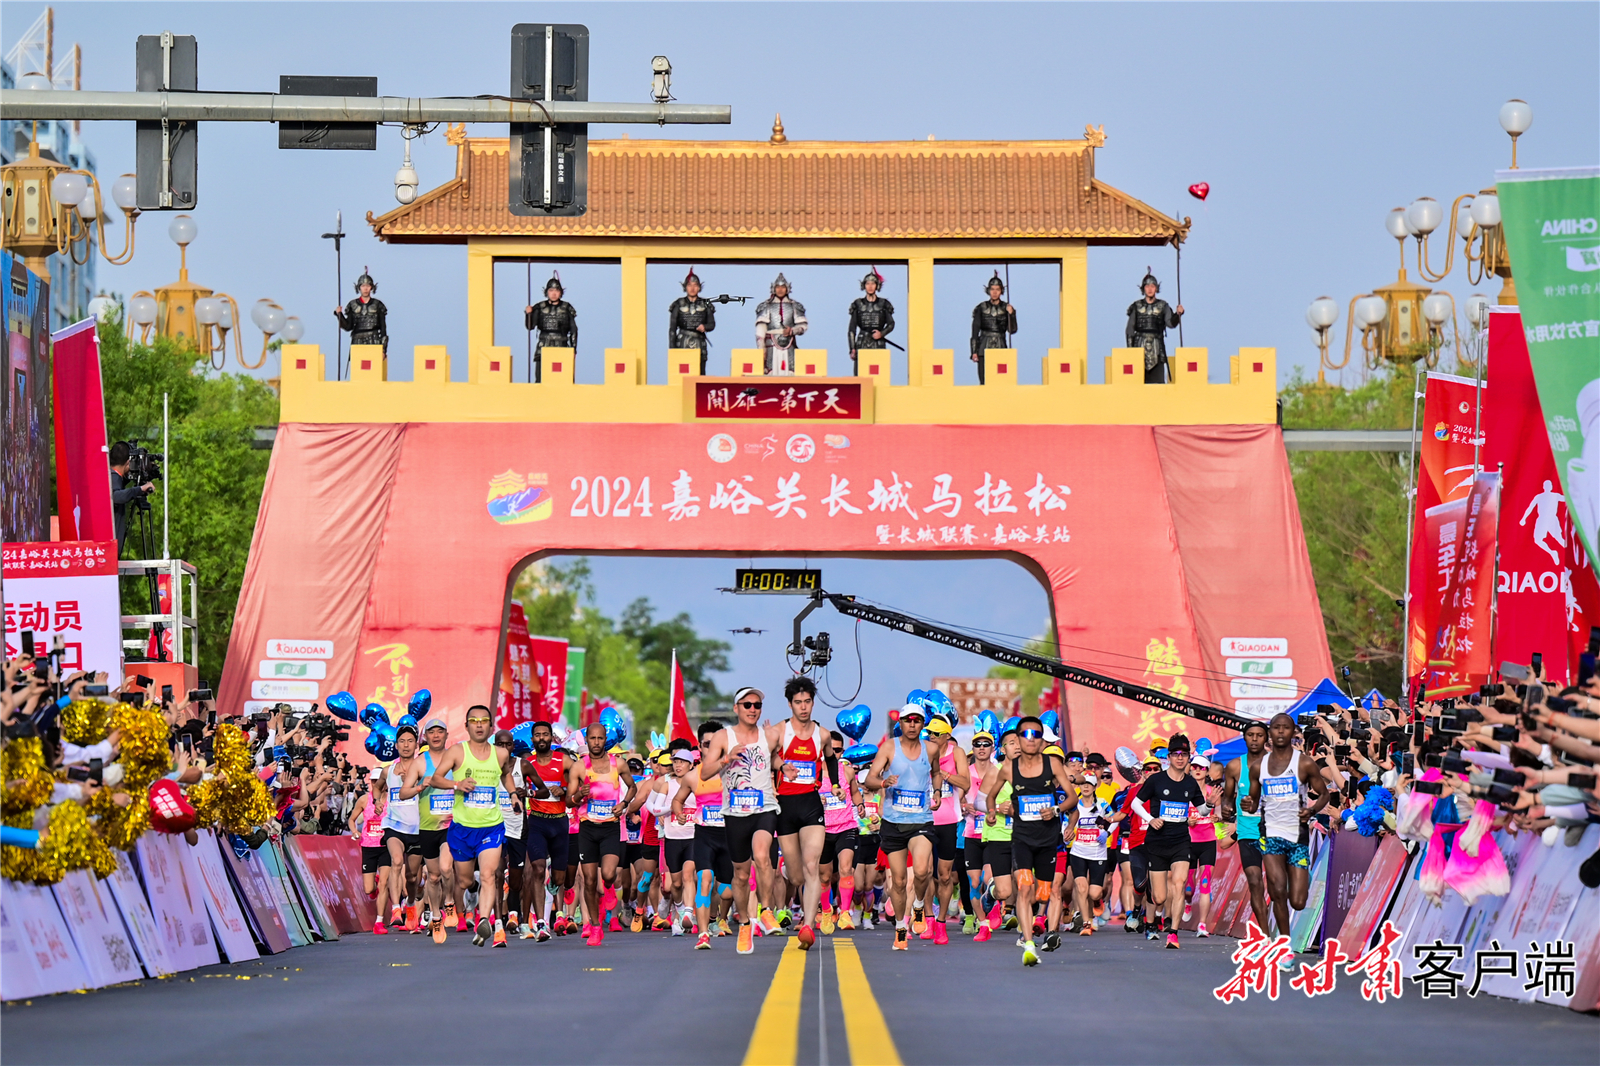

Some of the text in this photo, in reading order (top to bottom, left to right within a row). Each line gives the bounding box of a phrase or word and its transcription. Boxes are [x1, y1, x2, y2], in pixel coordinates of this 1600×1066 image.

[742, 573, 816, 591] 0:00:14
[283, 645, 326, 654] QIAODAN
[1238, 644, 1280, 652] QIAODAN
[1267, 784, 1293, 793] A10934
[1164, 806, 1185, 816] A10927
